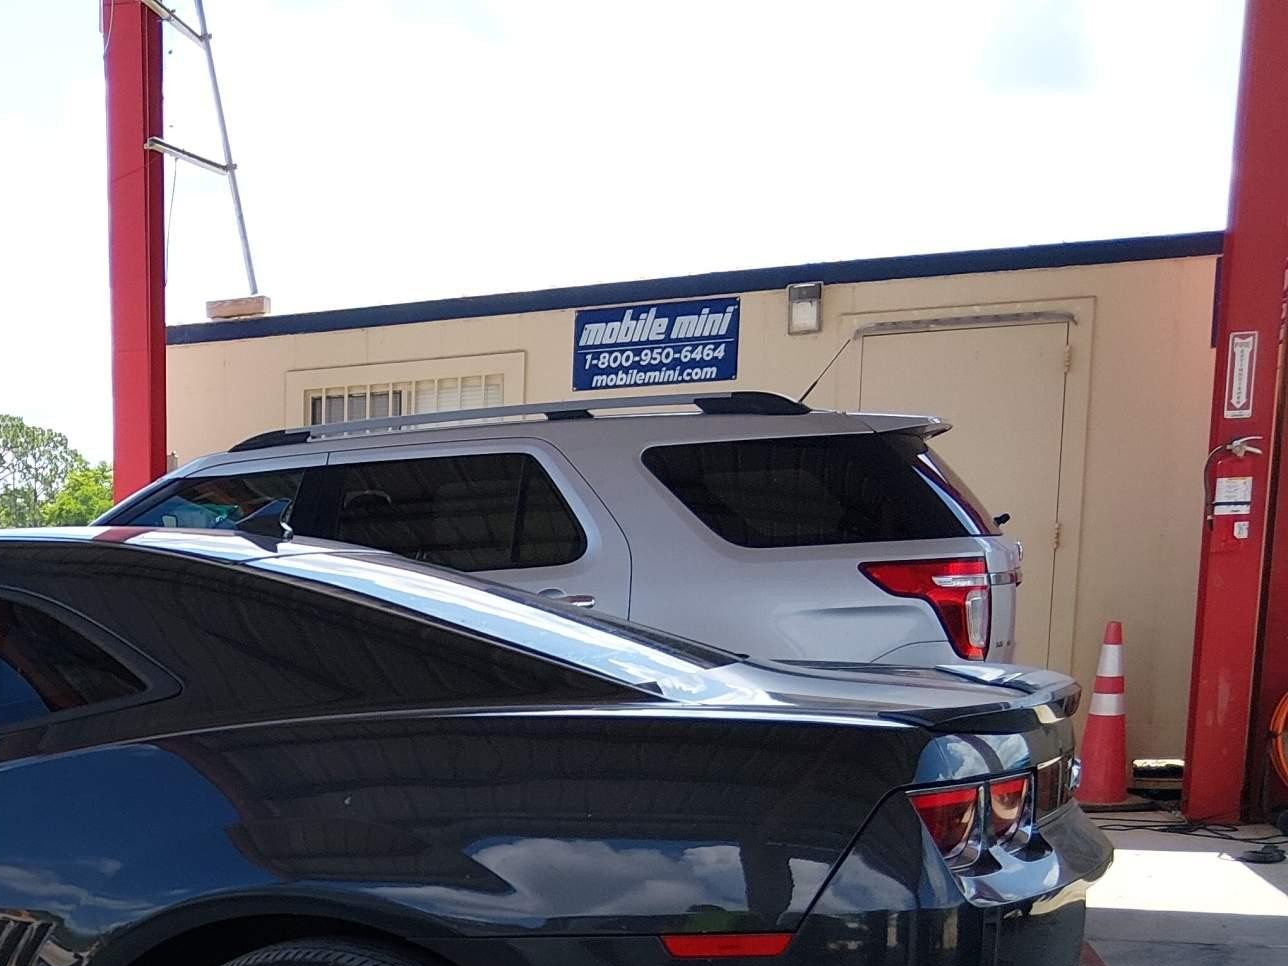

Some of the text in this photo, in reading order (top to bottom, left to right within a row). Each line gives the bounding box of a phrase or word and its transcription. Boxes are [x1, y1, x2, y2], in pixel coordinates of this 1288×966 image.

[579, 306, 733, 346] mobile mini
[585, 344, 725, 369] 1-800-950-6464
[592, 365, 717, 387] mobilemini.com
